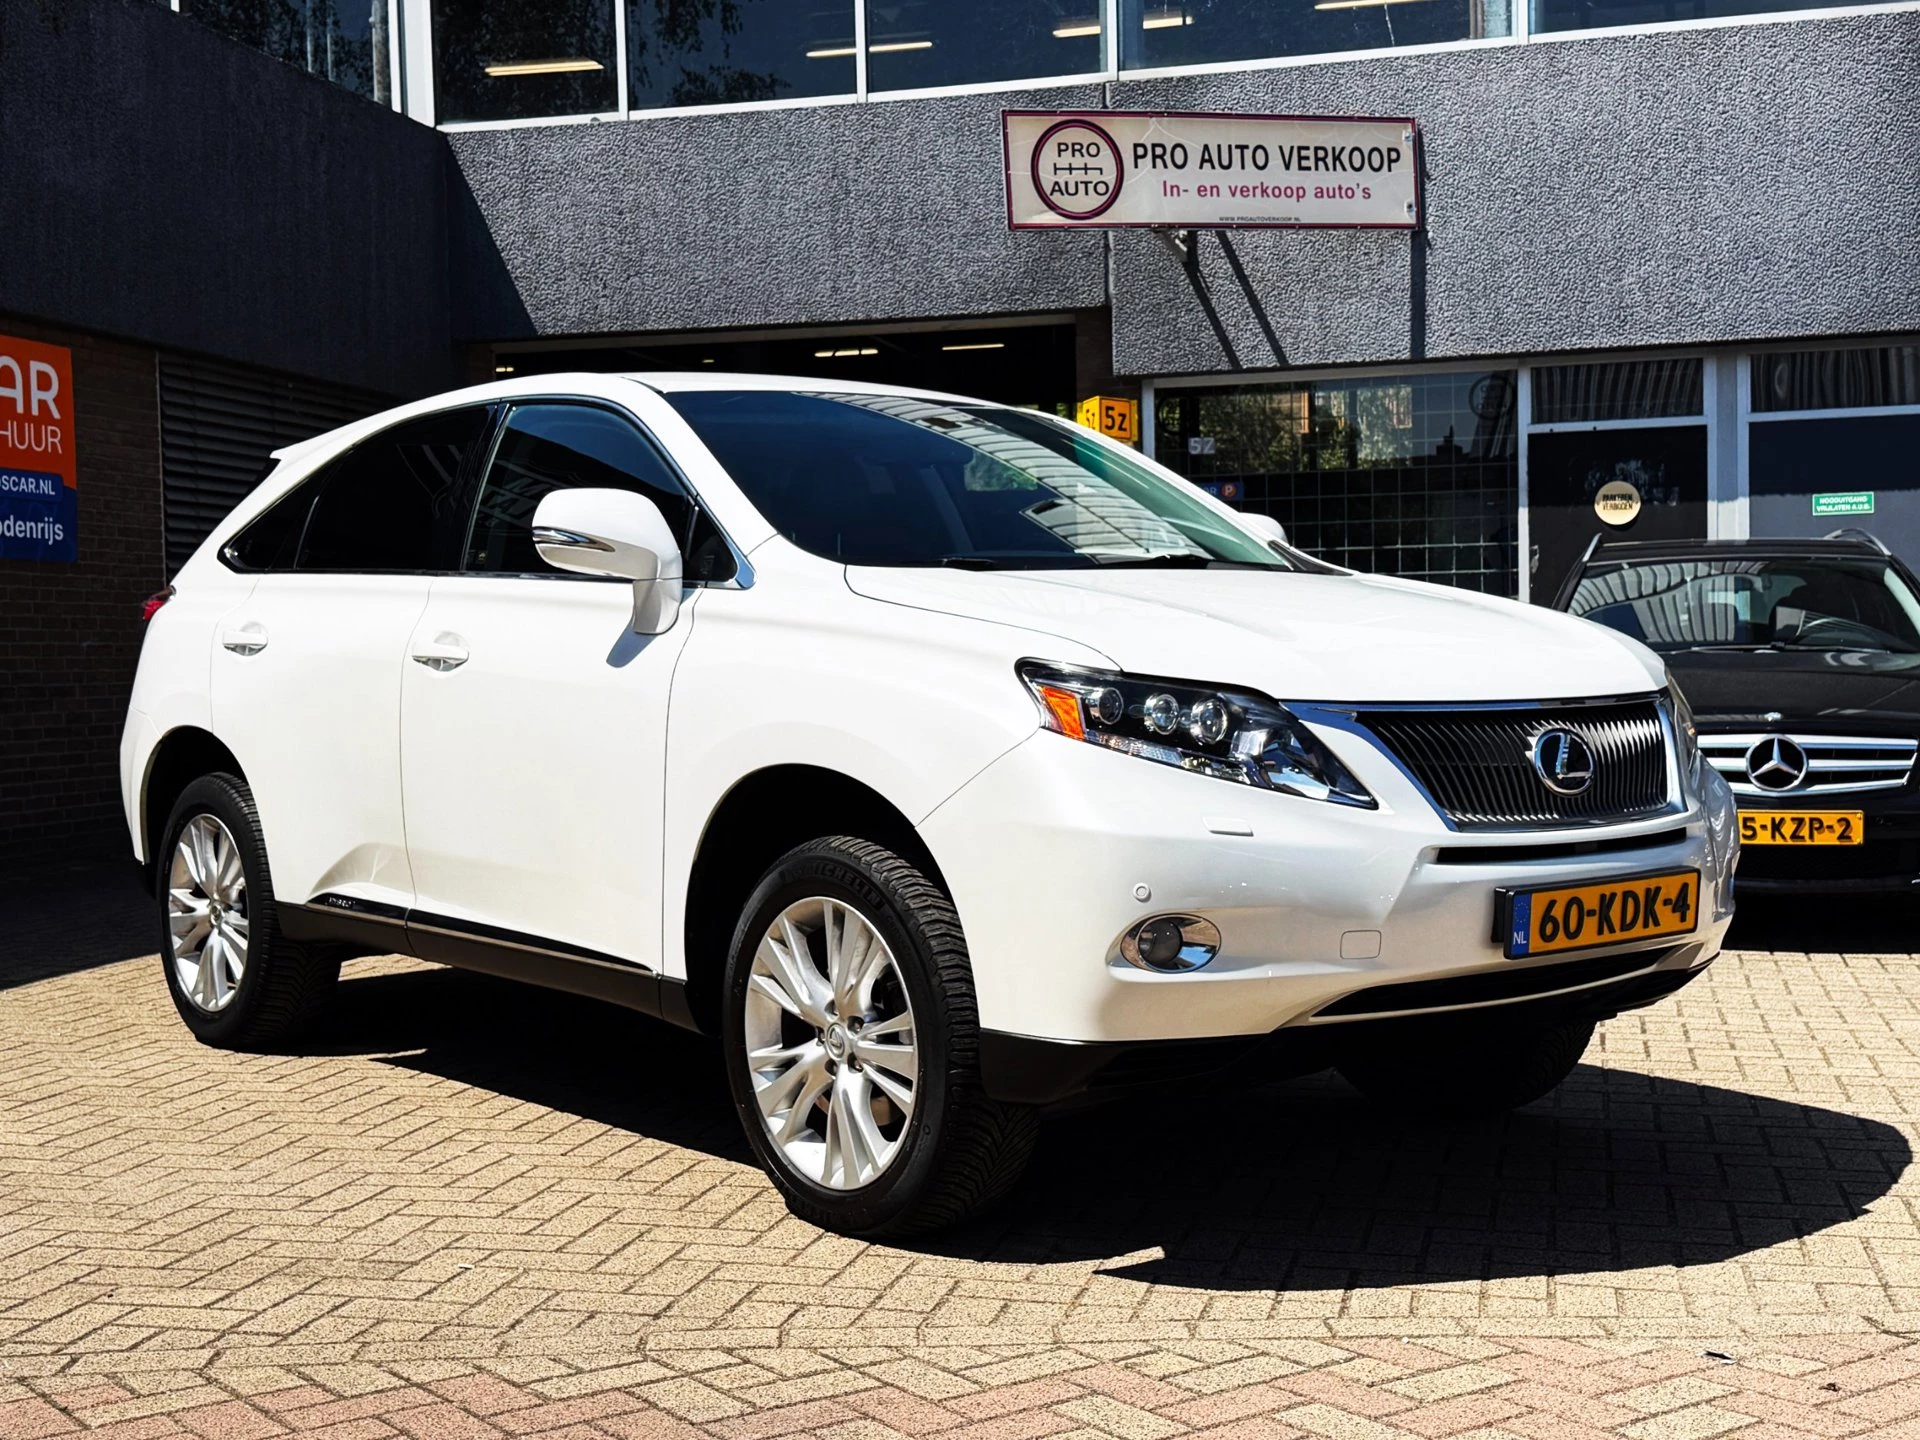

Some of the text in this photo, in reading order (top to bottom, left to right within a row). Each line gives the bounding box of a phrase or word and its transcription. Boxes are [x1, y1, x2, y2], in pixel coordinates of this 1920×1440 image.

[1057, 142, 1101, 158] PRO
[1132, 142, 1401, 173] PRO AUTO VERKOOP
[1049, 180, 1110, 197] AUTO
[1162, 180, 1372, 202] In- en verkoop auto's
[0, 475, 56, 496] SCAR.NL
[0, 515, 64, 545] denrijs
[1538, 882, 1691, 944] 60-KDK-4
[1512, 930, 1527, 946] NL
